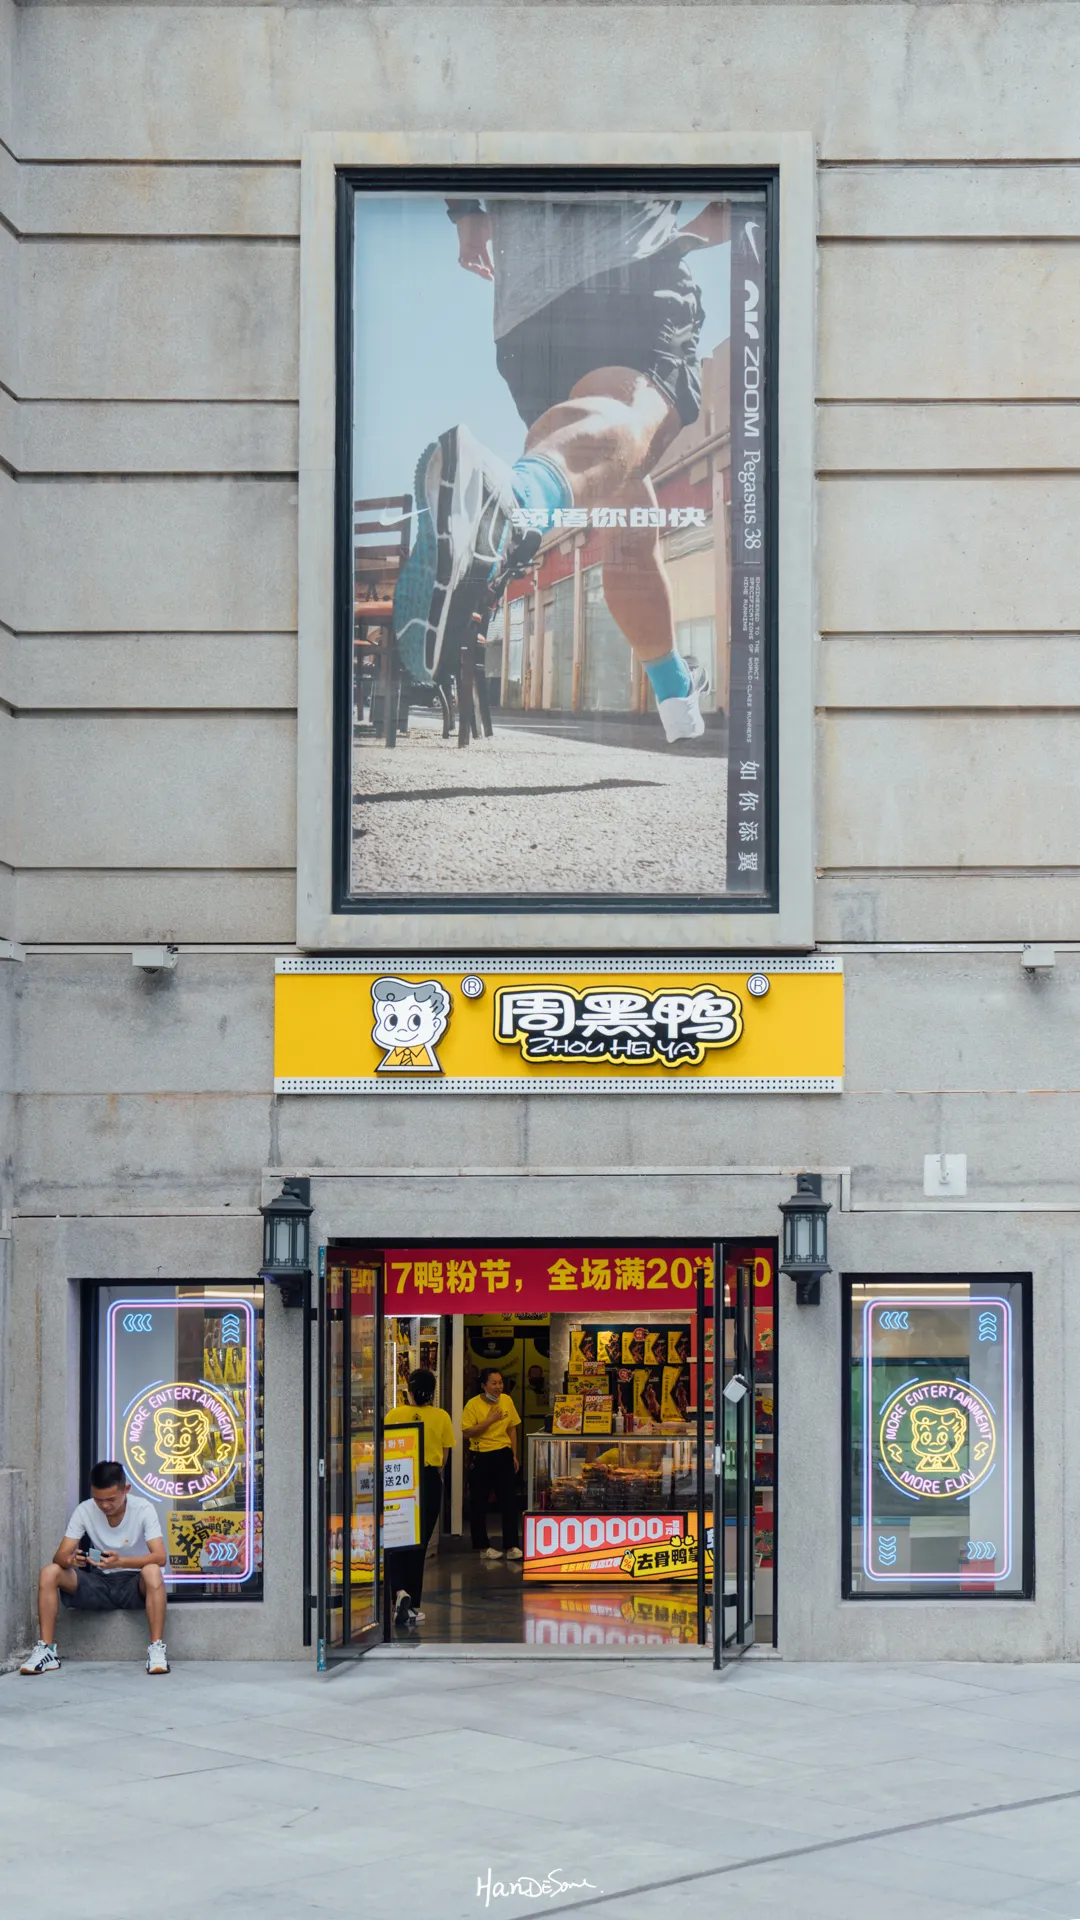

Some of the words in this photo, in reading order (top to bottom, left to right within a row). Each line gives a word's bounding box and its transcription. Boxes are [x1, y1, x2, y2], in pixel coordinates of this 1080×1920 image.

[744, 345, 760, 437] ZOOM
[737, 449, 761, 524] Pegasus
[511, 506, 706, 528] 领悟你的快
[744, 528, 761, 550] 38
[738, 760, 760, 872] 如你添翼
[501, 991, 735, 1039] 周黑鸭
[529, 1037, 604, 1055] ZHOU
[610, 1040, 651, 1056] HEI
[656, 1039, 696, 1059] YA
[129, 1407, 151, 1443] MORE
[148, 1386, 236, 1444] ENTERTAINMENT
[886, 1405, 907, 1440] MORE
[904, 1385, 992, 1440] ENTERTAINMENT
[143, 1471, 185, 1496] MORE
[188, 1470, 220, 1495] FUN
[900, 1471, 941, 1494] MORE
[944, 1469, 976, 1493] FUN
[526, 1517, 664, 1557] 1000000
